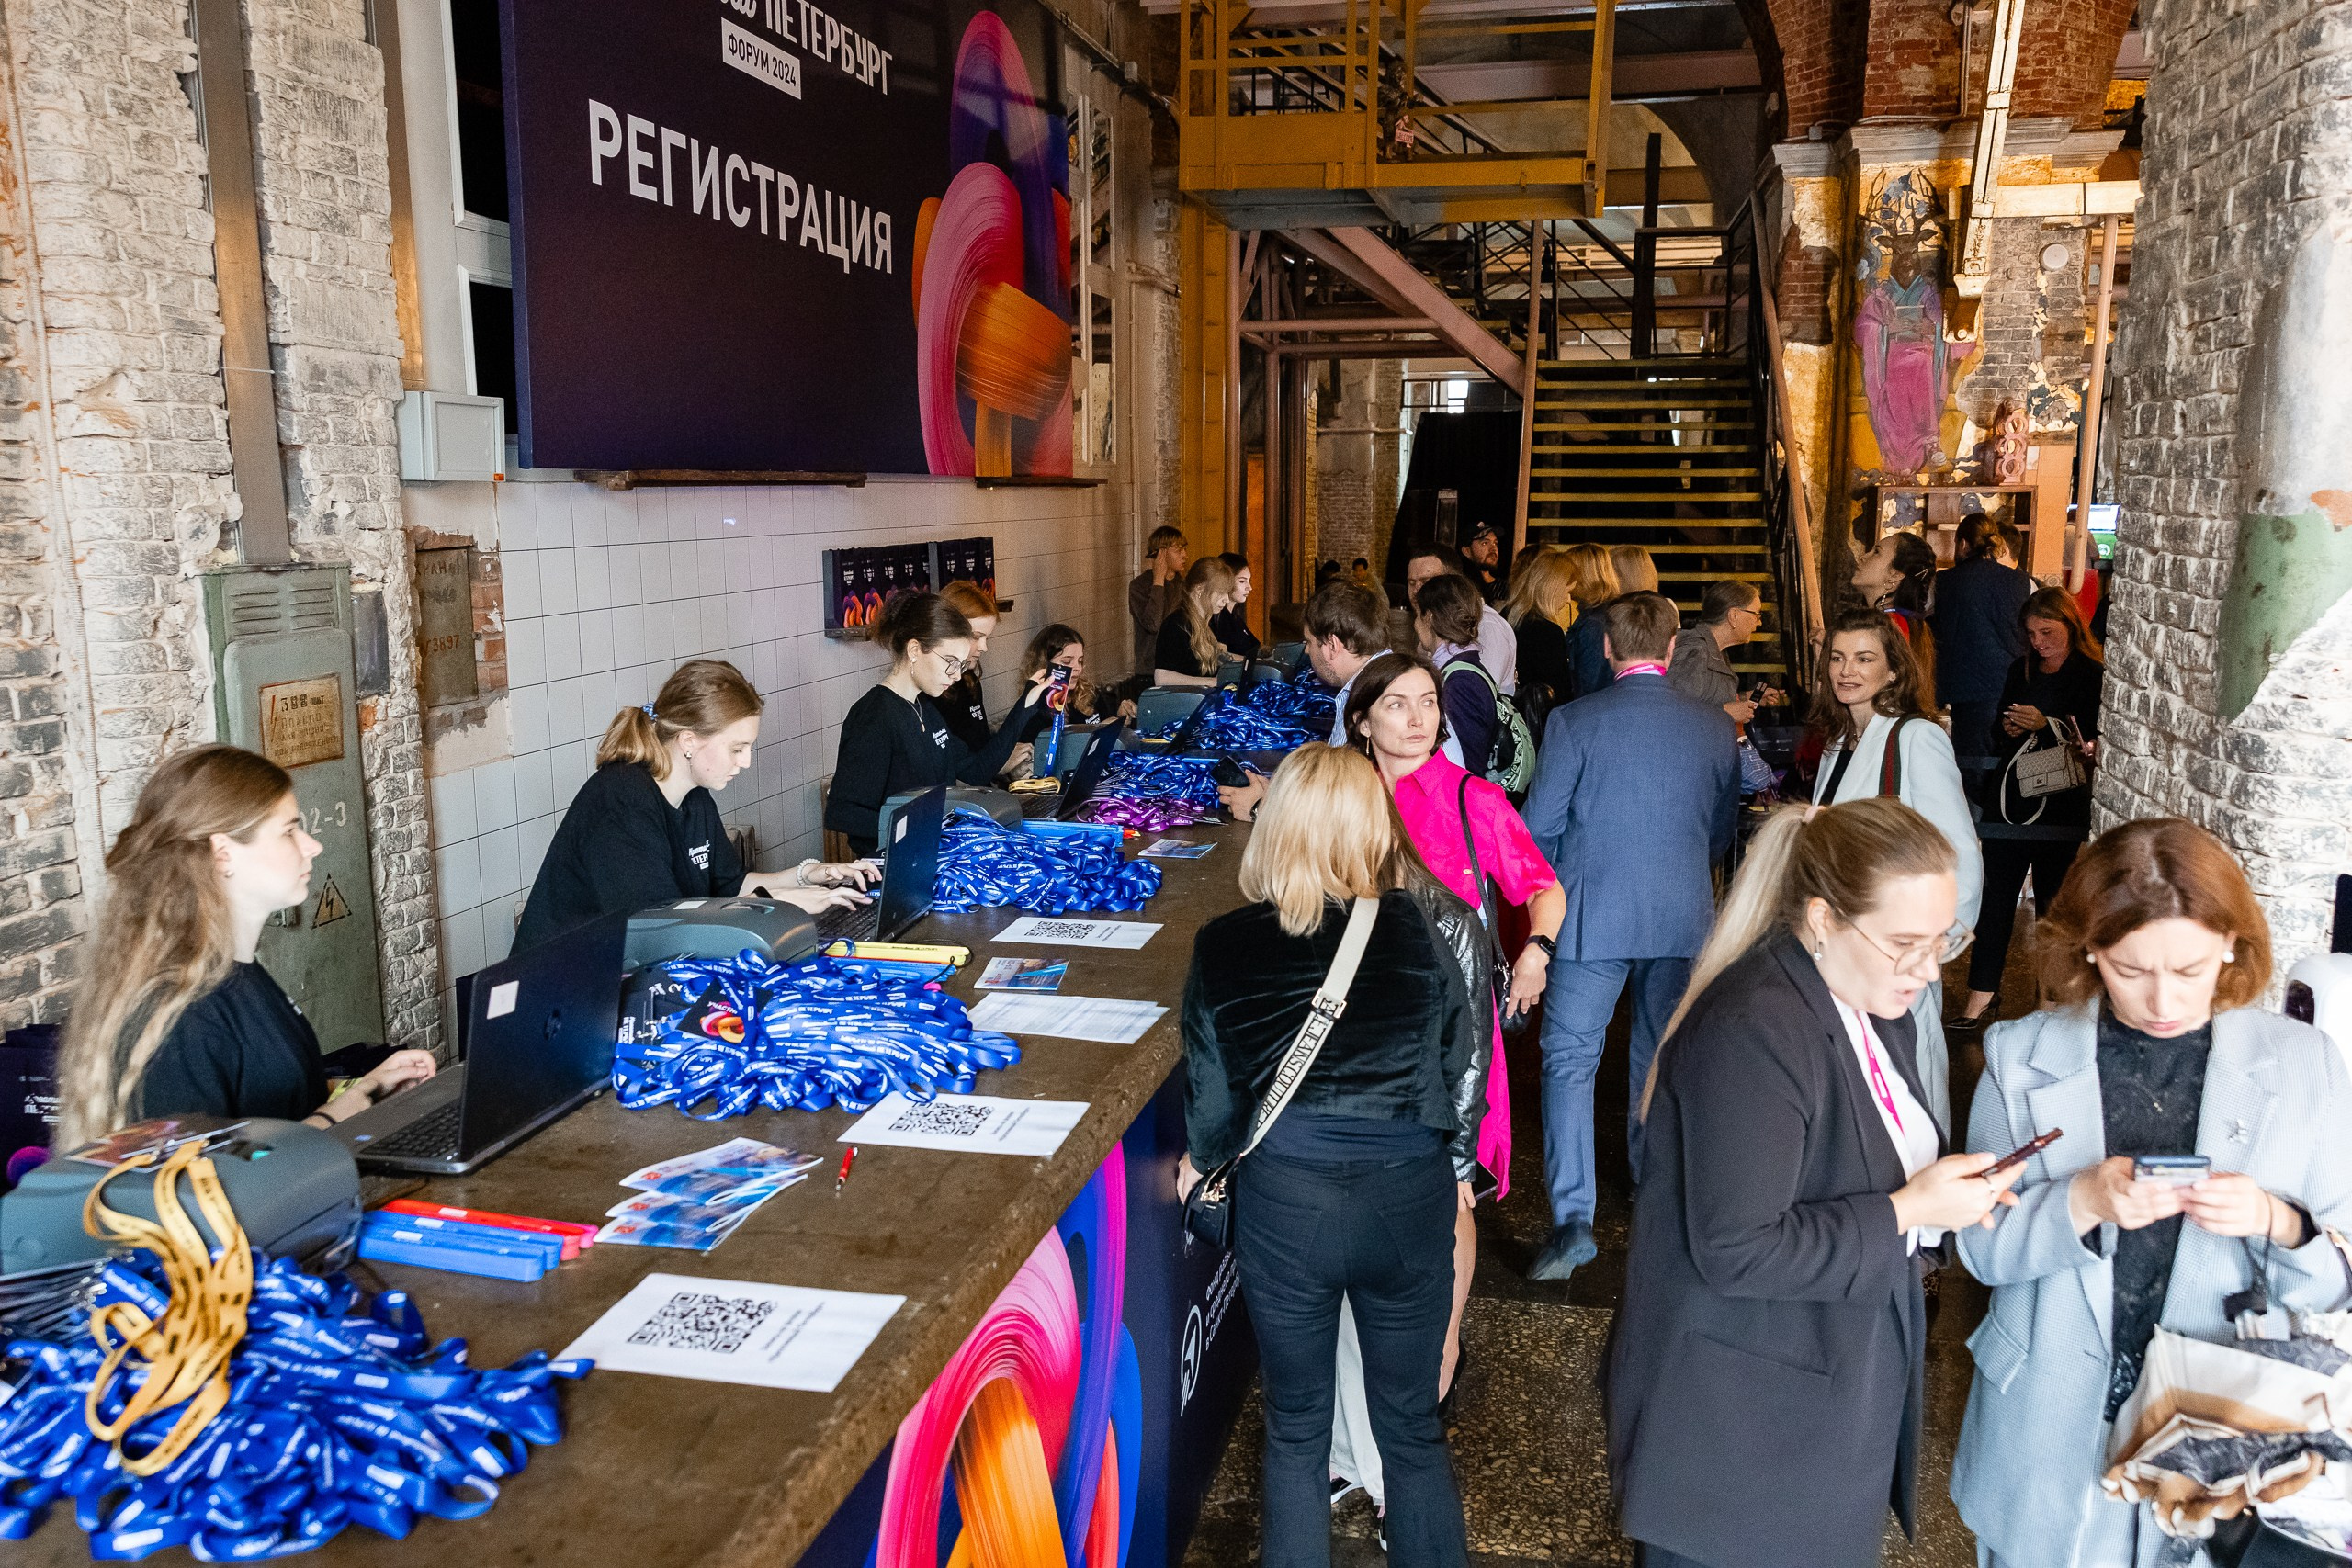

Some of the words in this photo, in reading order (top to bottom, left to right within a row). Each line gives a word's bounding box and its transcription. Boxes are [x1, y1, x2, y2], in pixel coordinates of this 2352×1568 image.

[728, 33, 770, 74] ФОРУМ
[772, 56, 797, 86] 2024
[765, 0, 892, 96] ПЕТЕРБУРГ
[588, 98, 892, 275] РЕГИСТРАЦИЯ
